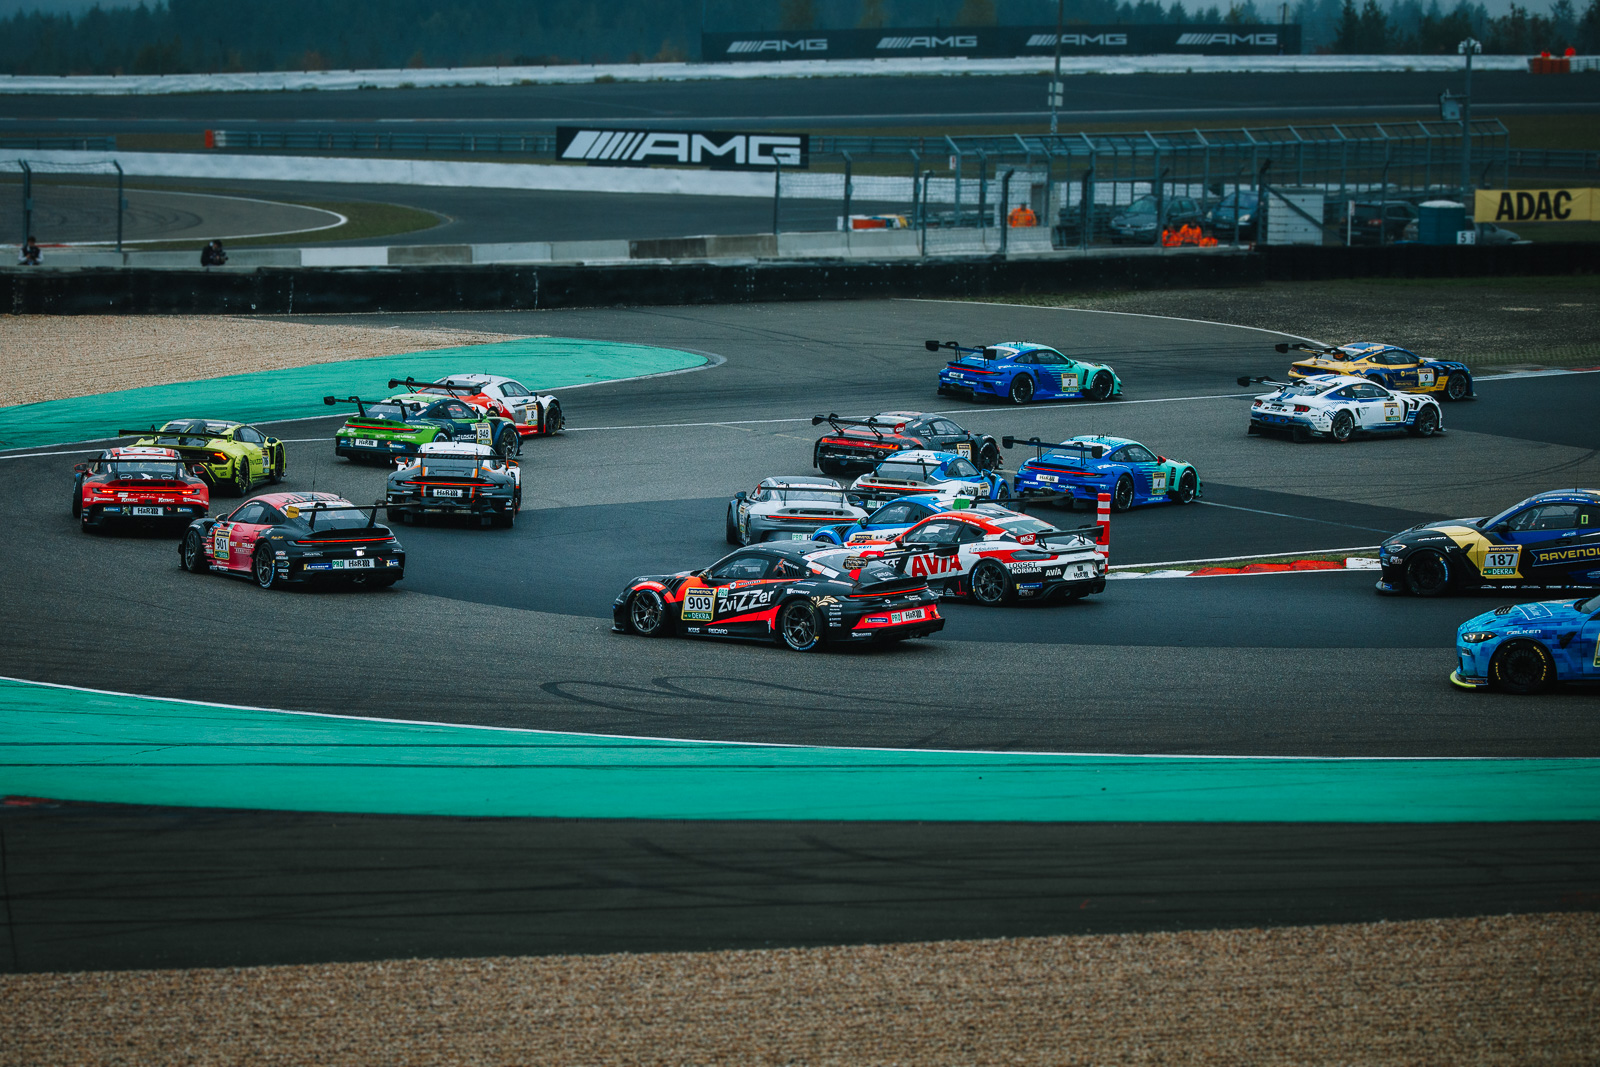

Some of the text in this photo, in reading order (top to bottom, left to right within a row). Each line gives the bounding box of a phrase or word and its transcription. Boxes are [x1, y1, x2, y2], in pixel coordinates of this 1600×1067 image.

[631, 132, 801, 165] AMG
[1495, 190, 1572, 221] ADAC
[1424, 373, 1429, 382] 9
[1389, 408, 1395, 416] 6
[961, 450, 969, 459] 22
[216, 537, 227, 550] 901
[1008, 562, 1037, 570] LOGSET
[1490, 554, 1515, 566] 187
[687, 596, 711, 610] 909
